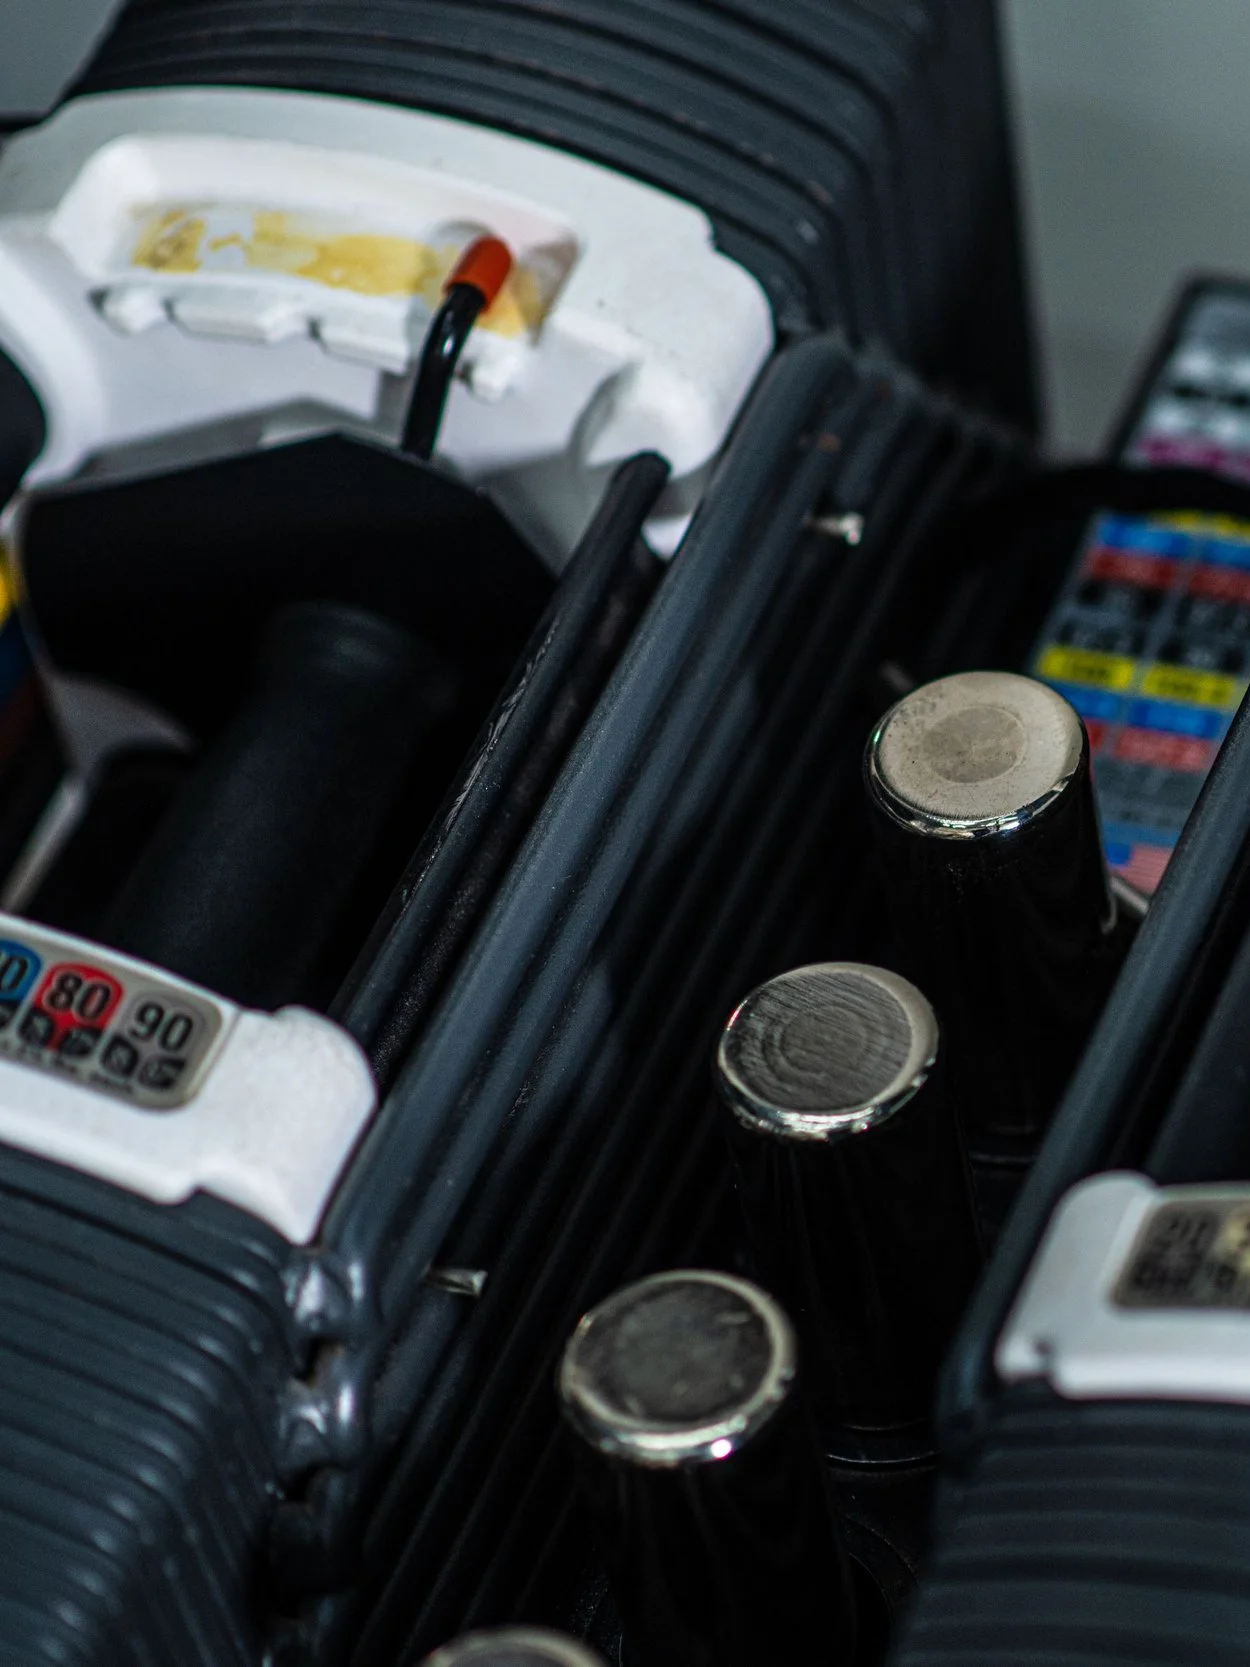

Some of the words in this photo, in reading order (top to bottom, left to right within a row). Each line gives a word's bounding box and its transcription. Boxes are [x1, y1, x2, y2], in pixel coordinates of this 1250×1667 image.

[0, 951, 29, 992] 0
[47, 972, 112, 1020] 80
[128, 1001, 194, 1052] 90
